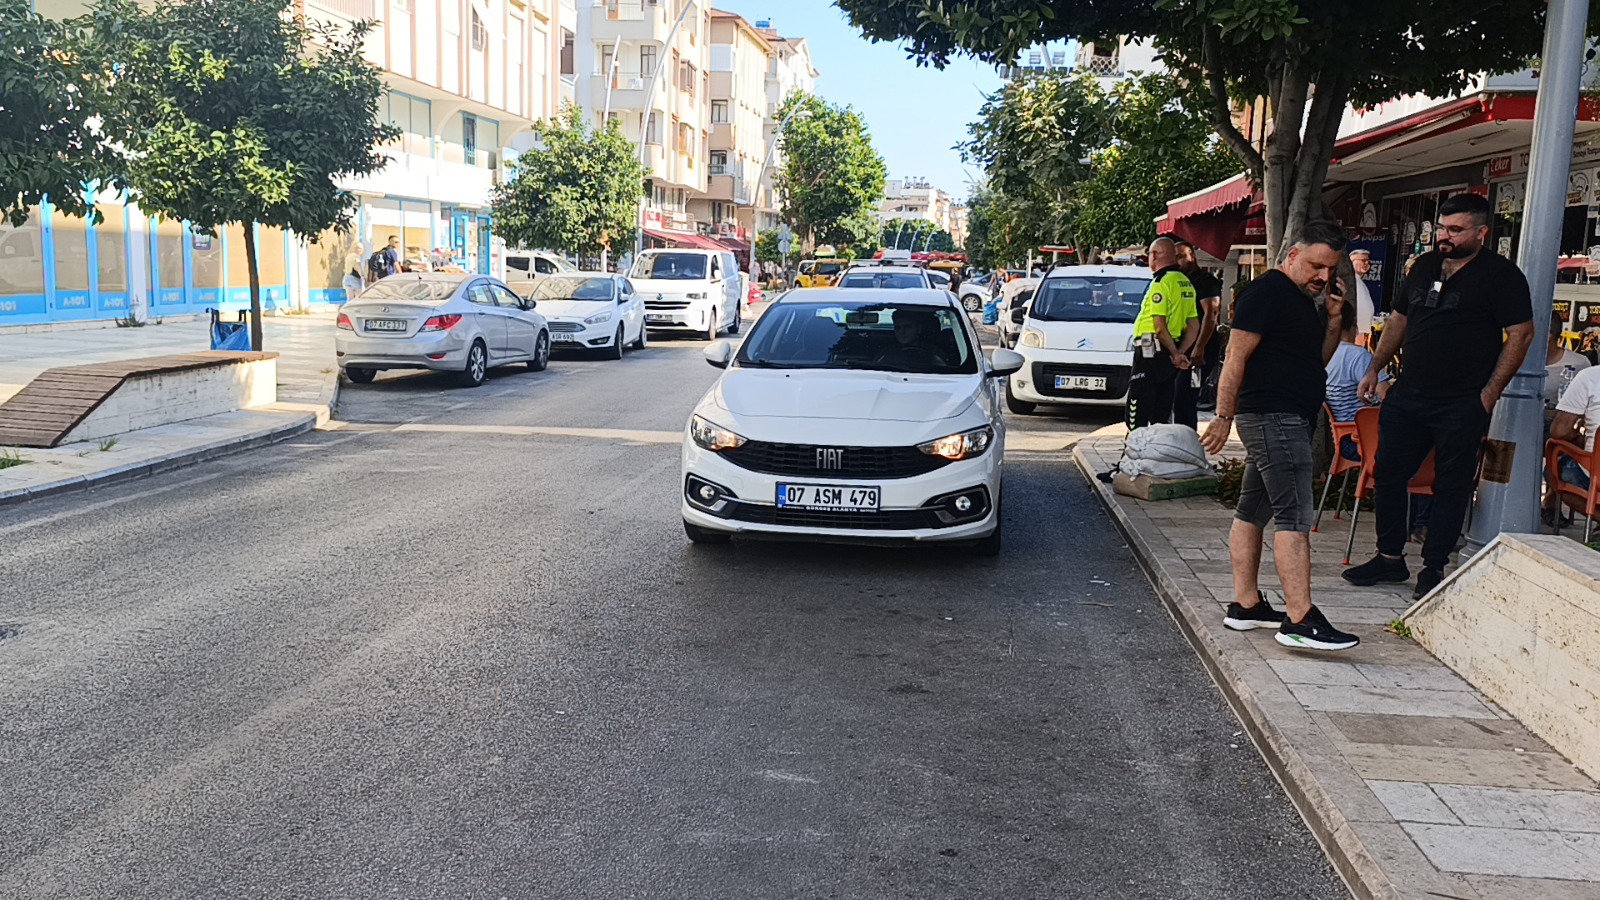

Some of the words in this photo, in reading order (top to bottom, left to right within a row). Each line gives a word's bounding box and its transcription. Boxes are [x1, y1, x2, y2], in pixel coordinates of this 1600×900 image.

[63, 296, 85, 307] A-101
[103, 297, 124, 308] A-101
[369, 321, 378, 329] 07
[379, 321, 392, 329] AFC
[1060, 377, 1070, 386] 07
[1074, 378, 1089, 387] LRG
[1094, 379, 1104, 388] 32
[816, 448, 844, 469] FIAT
[787, 487, 805, 503] 07
[814, 488, 842, 505] ASM
[849, 490, 877, 506] 479
